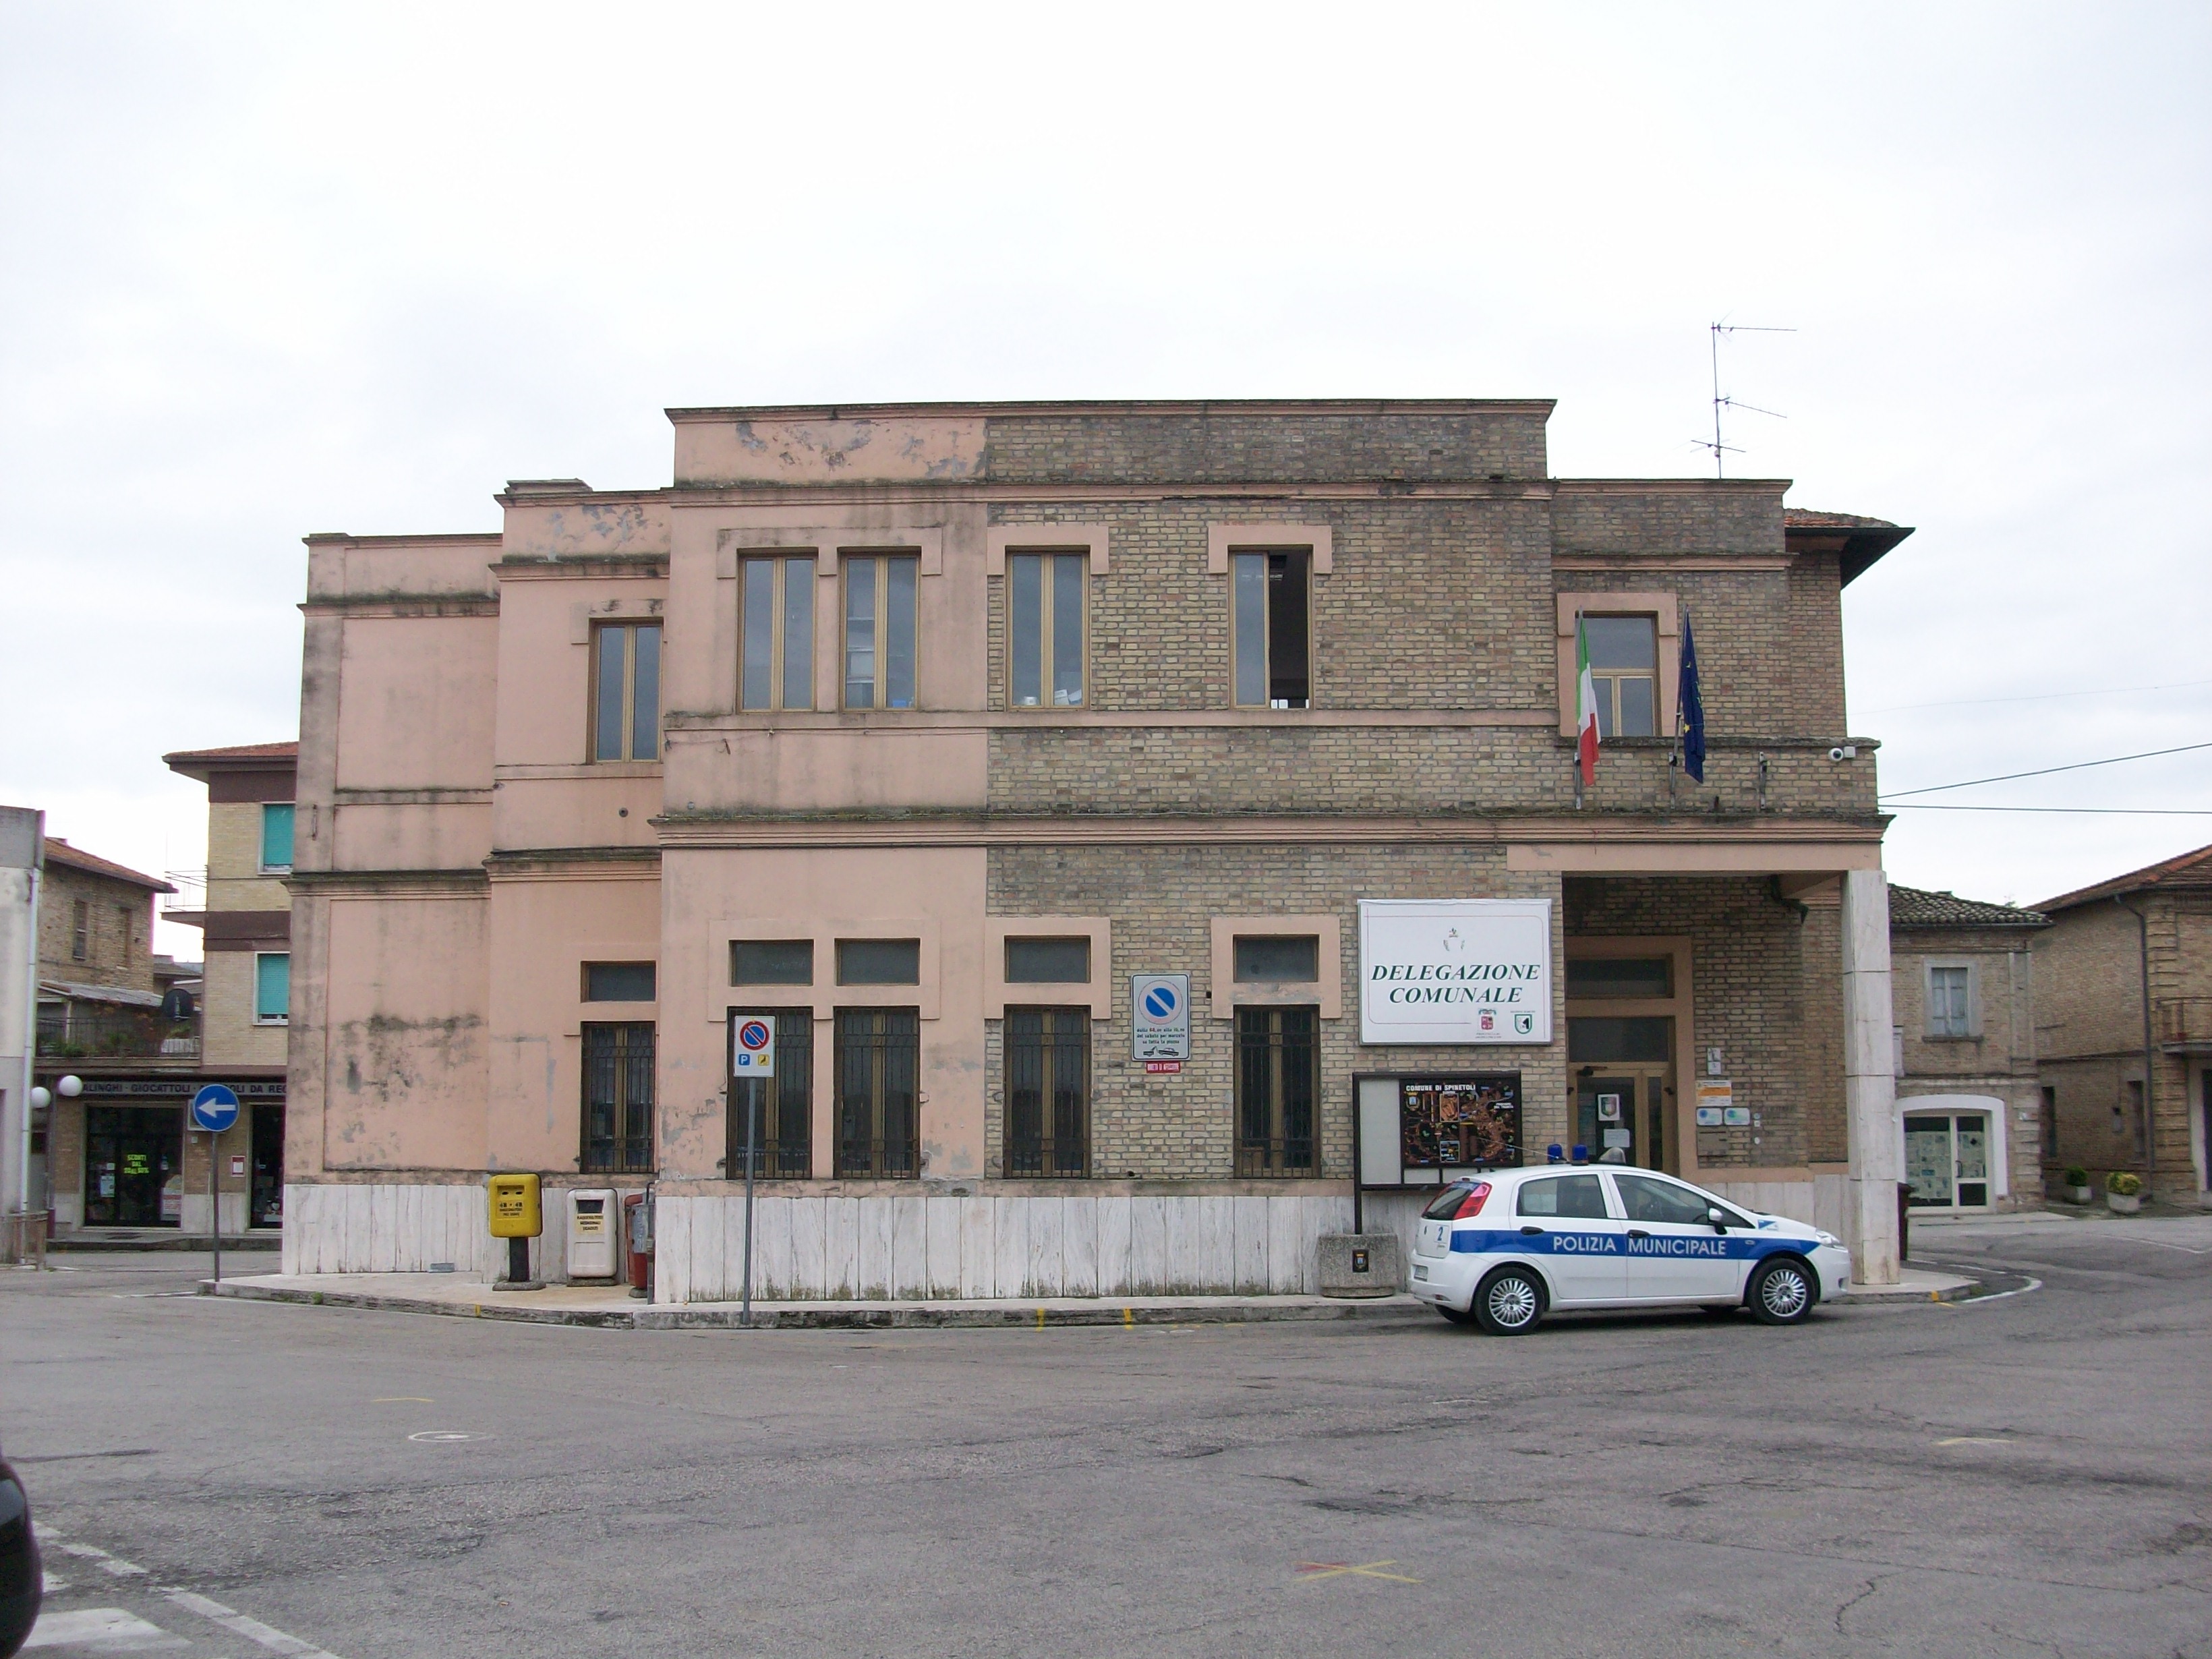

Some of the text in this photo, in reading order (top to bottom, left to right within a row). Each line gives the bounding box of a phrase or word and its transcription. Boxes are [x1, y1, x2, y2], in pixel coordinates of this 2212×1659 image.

[1370, 964, 1540, 981] DELEGAZIONE
[1389, 987, 1523, 1003] COMUNALE
[740, 1055, 748, 1064] P
[82, 1083, 122, 1092] ALINGHI
[131, 1084, 191, 1093] GIOCATTOLI
[250, 1084, 263, 1093] DA
[1436, 1226, 1443, 1241] 2
[1552, 1236, 1726, 1255] POLIZIA MUNICIPALE
